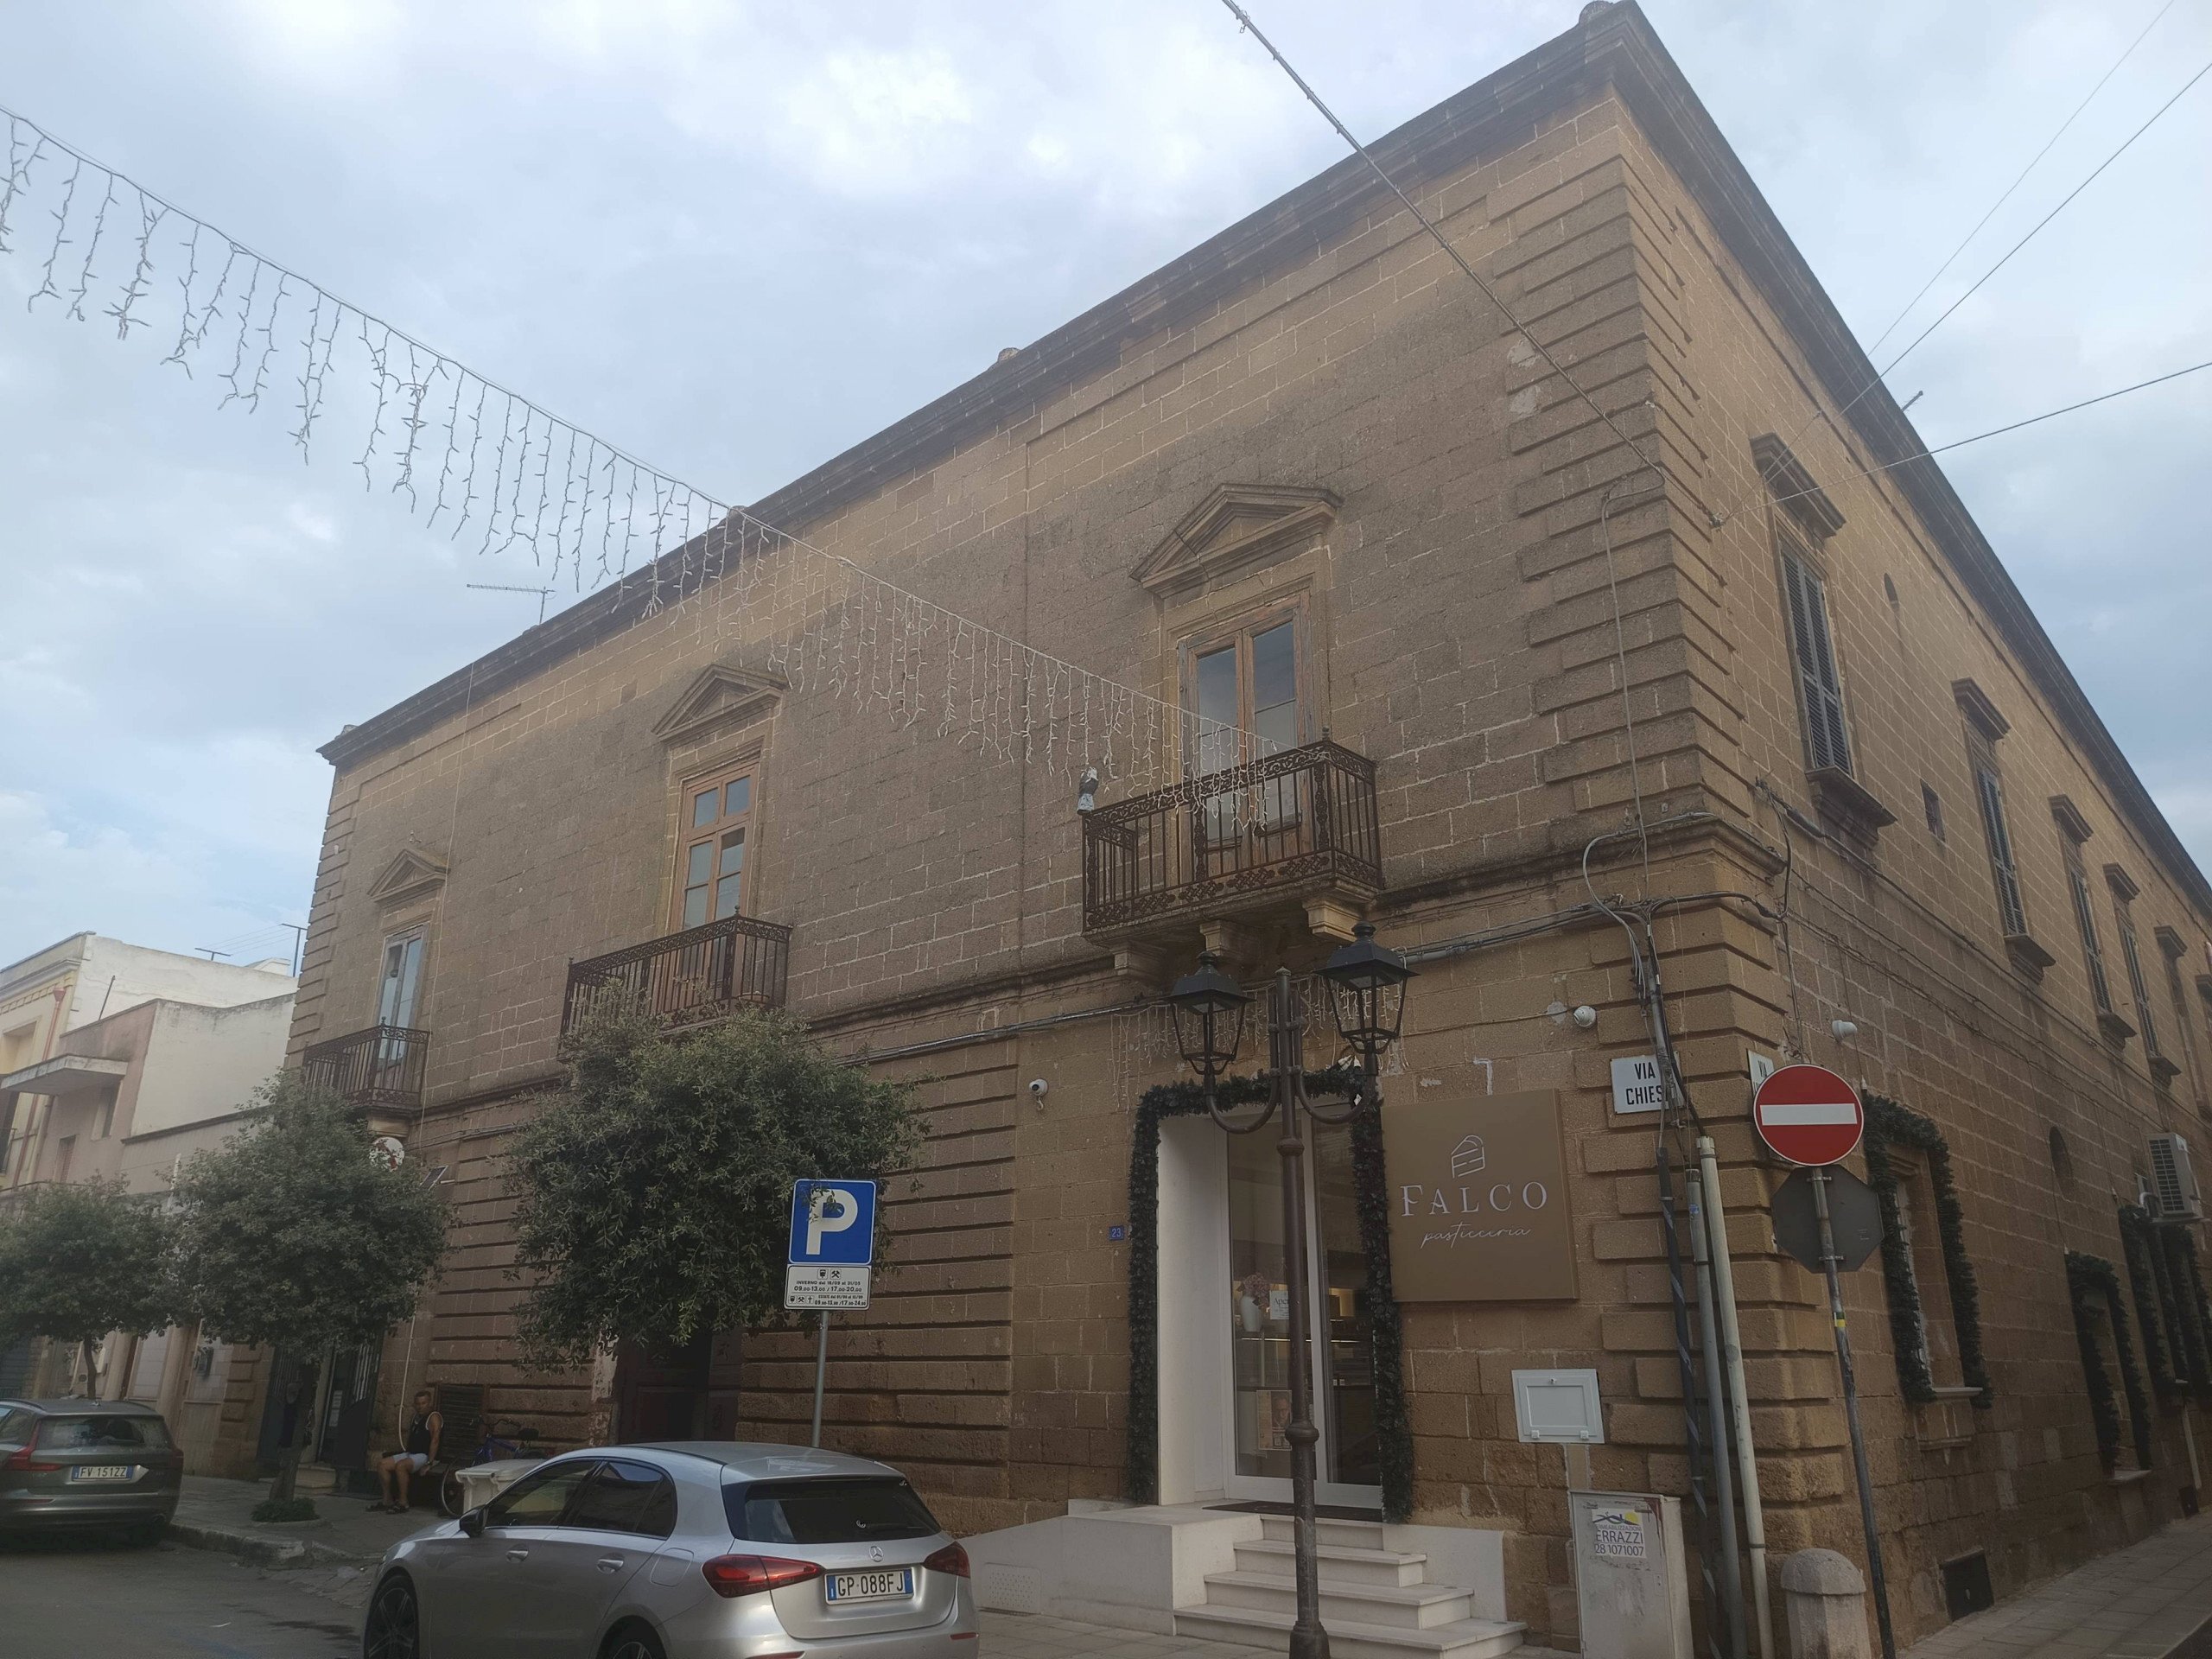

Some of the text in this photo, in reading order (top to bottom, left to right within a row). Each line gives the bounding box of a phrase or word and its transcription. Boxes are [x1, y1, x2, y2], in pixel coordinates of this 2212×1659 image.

[1634, 1062, 1656, 1079] VIA
[1625, 1085, 1662, 1105] CHIES
[1400, 1181, 1548, 1217] FALCO
[805, 1188, 858, 1255] P
[1111, 1227, 1122, 1237] 23
[1420, 1221, 1532, 1249] pasticceria
[79, 1466, 92, 1477] FV
[1595, 1544, 1644, 1556] 28 1071007
[837, 1573, 904, 1596] GP 088FJ
